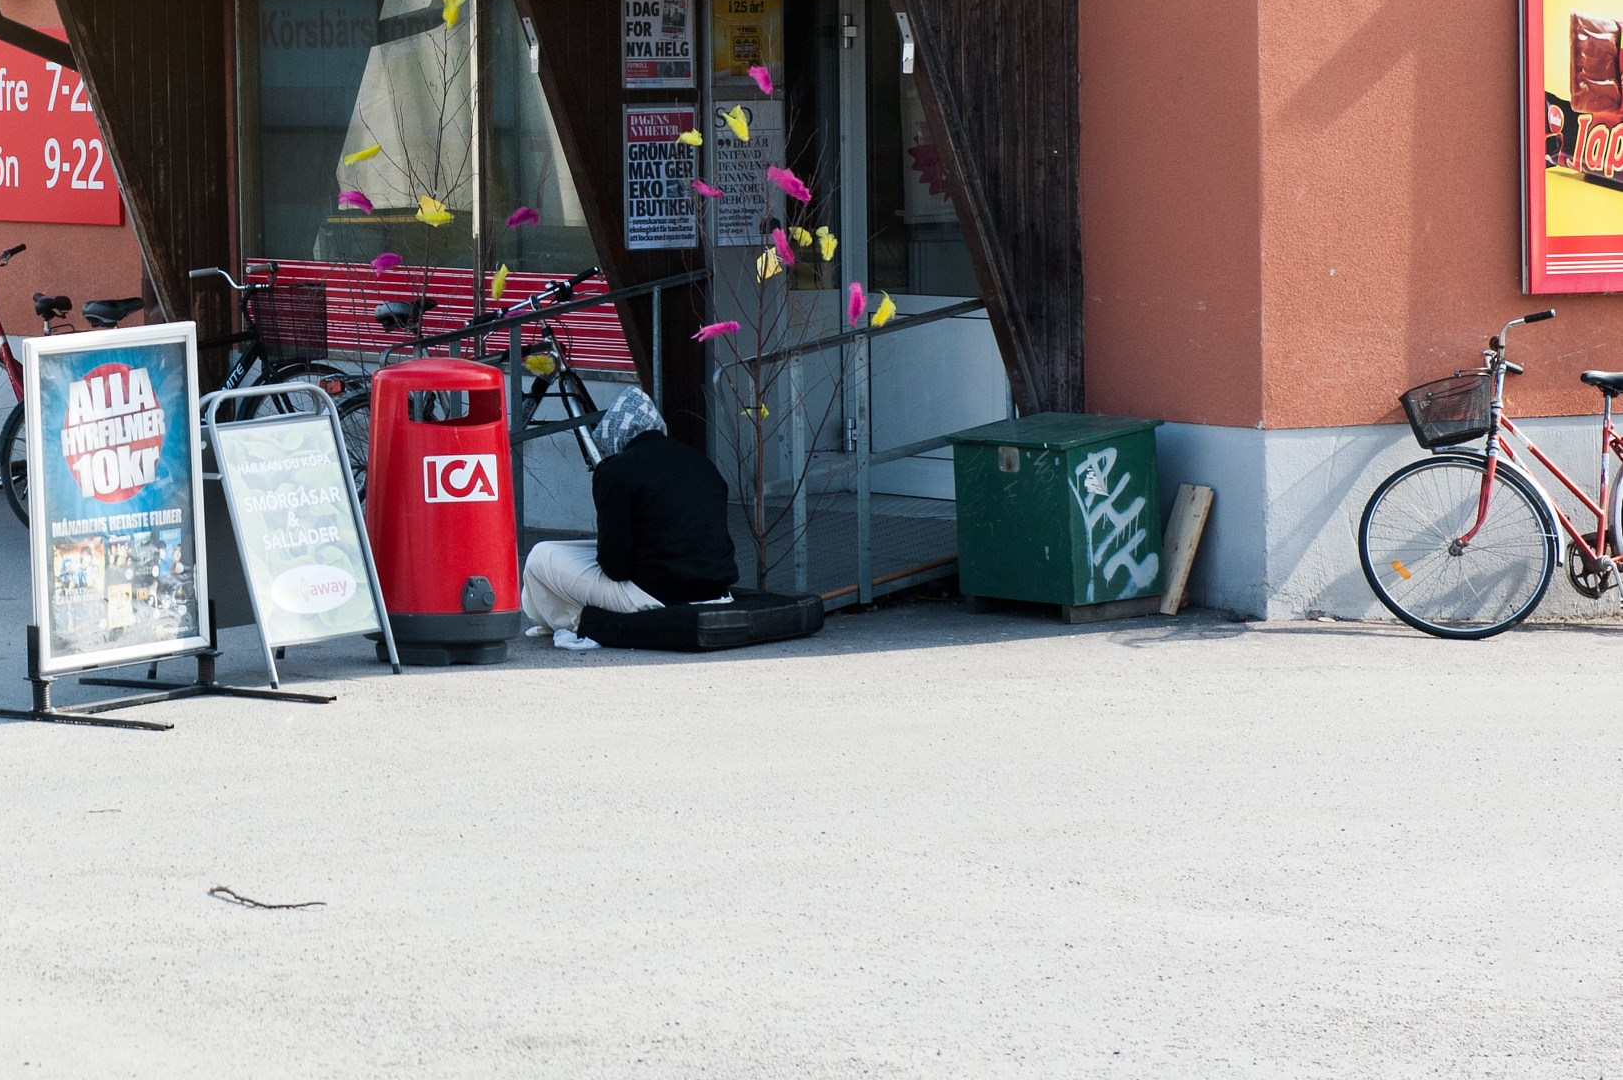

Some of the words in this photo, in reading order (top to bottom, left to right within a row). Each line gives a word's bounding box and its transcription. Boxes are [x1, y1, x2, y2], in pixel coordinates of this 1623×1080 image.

[625, 1, 630, 17] I
[633, 1, 660, 17] DAG
[728, 1, 732, 13] i
[733, 1, 748, 13] 25
[749, 1, 765, 13] år!
[626, 20, 652, 37] FÖR
[626, 41, 653, 58] NYA
[655, 41, 689, 57] HELG
[45, 61, 93, 112] 7-2
[630, 114, 670, 126] DAGENS
[715, 107, 753, 128] SD
[631, 125, 679, 137] NYHETER
[628, 142, 694, 161] GRÖNARE
[754, 137, 769, 148] ÄR
[44, 137, 105, 190] 9-22
[628, 161, 663, 180] MAT
[664, 161, 694, 178] GER
[629, 180, 664, 199] EKO
[629, 200, 634, 217] I
[635, 199, 695, 218] BUTIKEN
[68, 366, 155, 427] ALLA
[60, 407, 166, 458] HYRFILMER
[72, 443, 160, 500] 10kr
[236, 460, 257, 475] HÄR
[260, 460, 282, 473] KAN
[284, 458, 300, 469] DU
[302, 453, 331, 468] KÖPA
[427, 459, 496, 500] ICA
[244, 483, 341, 513] SMÖRGÅSAR
[51, 517, 108, 538] MÅNADENS
[108, 511, 149, 532] HETASTE
[148, 508, 182, 527] FILMER
[288, 510, 300, 528] &
[263, 525, 341, 551] SALLADER
[309, 580, 347, 597] away
